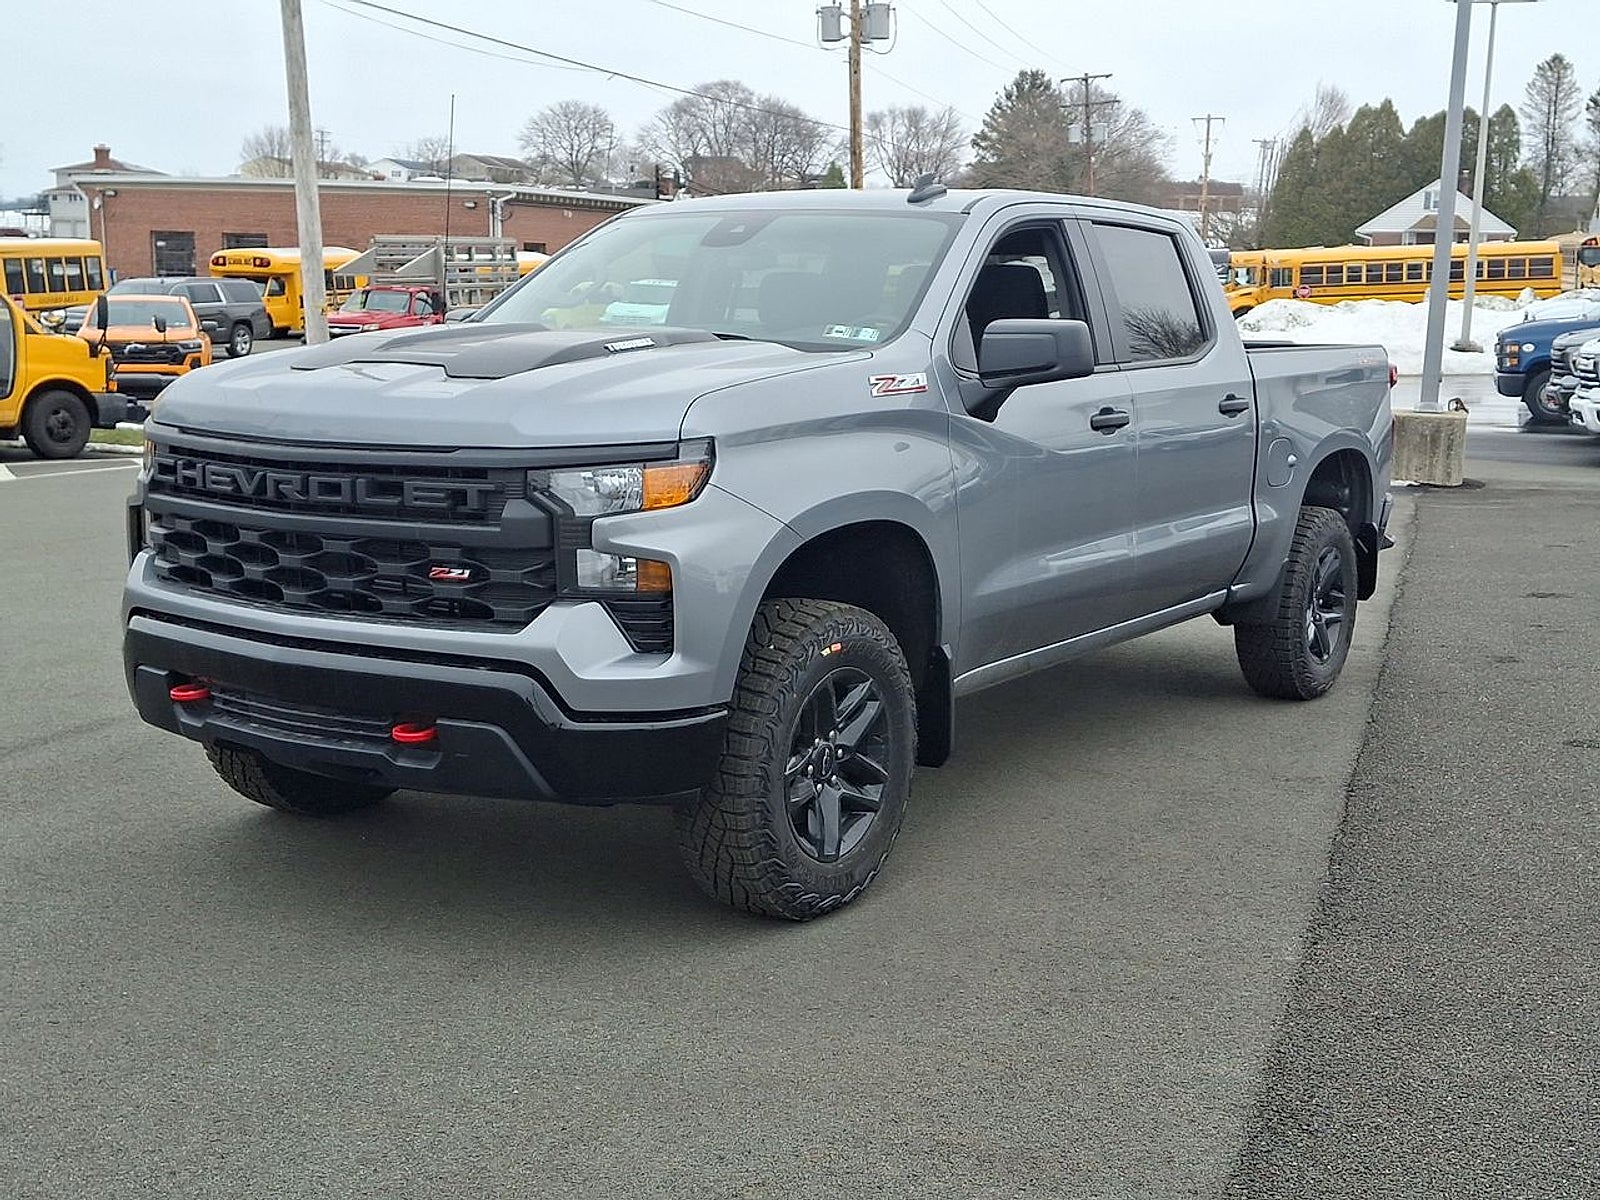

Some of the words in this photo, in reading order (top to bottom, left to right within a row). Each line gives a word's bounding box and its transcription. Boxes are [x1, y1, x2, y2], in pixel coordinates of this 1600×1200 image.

[869, 373, 928, 397] Z71
[152, 457, 497, 509] CHEVROLET
[429, 567, 470, 579] Z71
